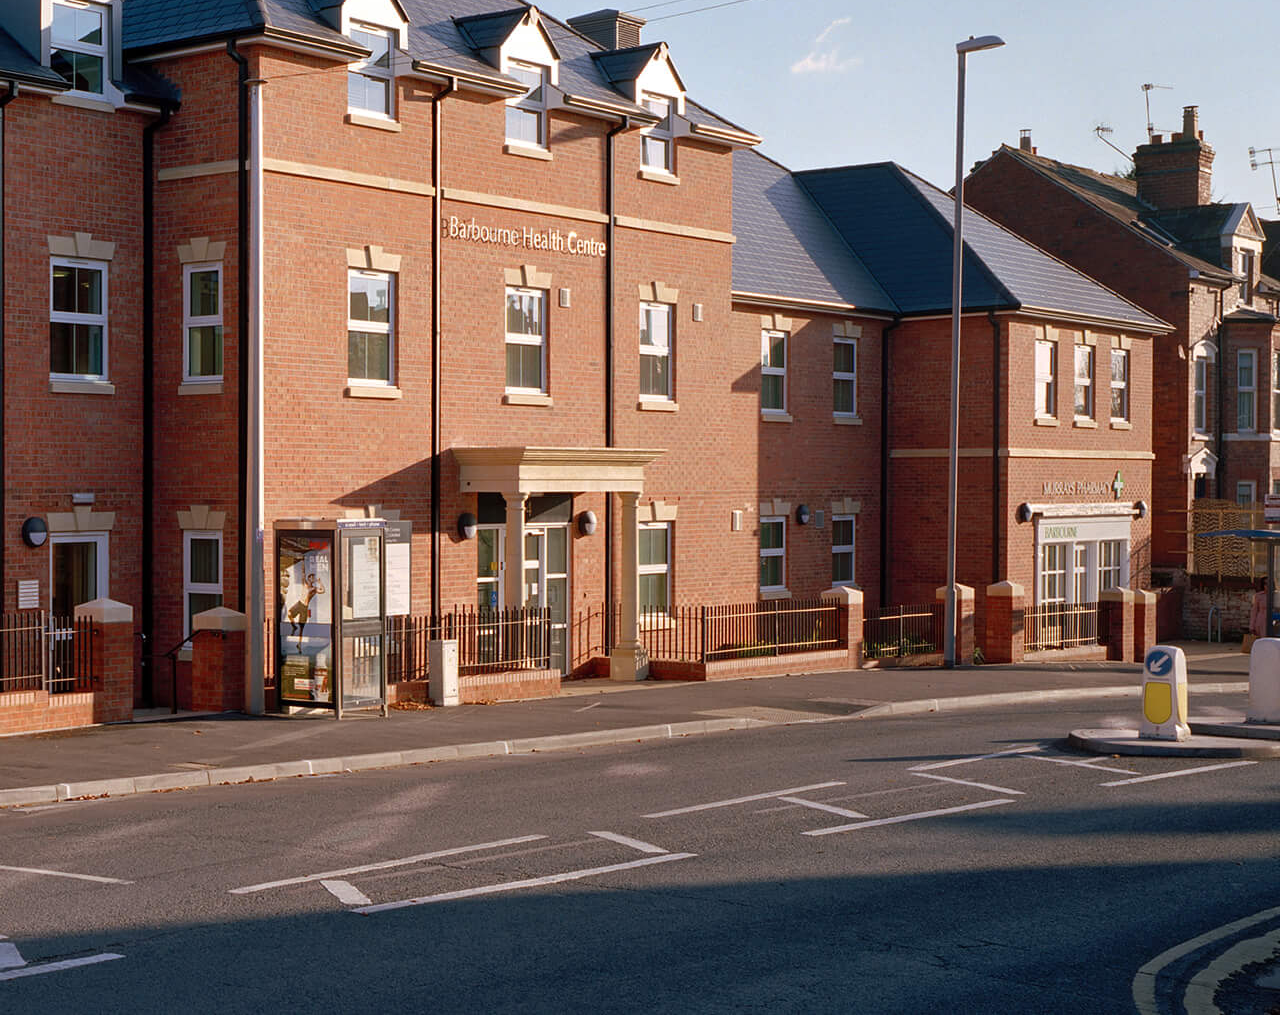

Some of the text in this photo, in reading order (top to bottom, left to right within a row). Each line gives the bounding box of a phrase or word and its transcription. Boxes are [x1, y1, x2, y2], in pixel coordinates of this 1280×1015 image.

[450, 216, 607, 257] Barbourne Health Centre
